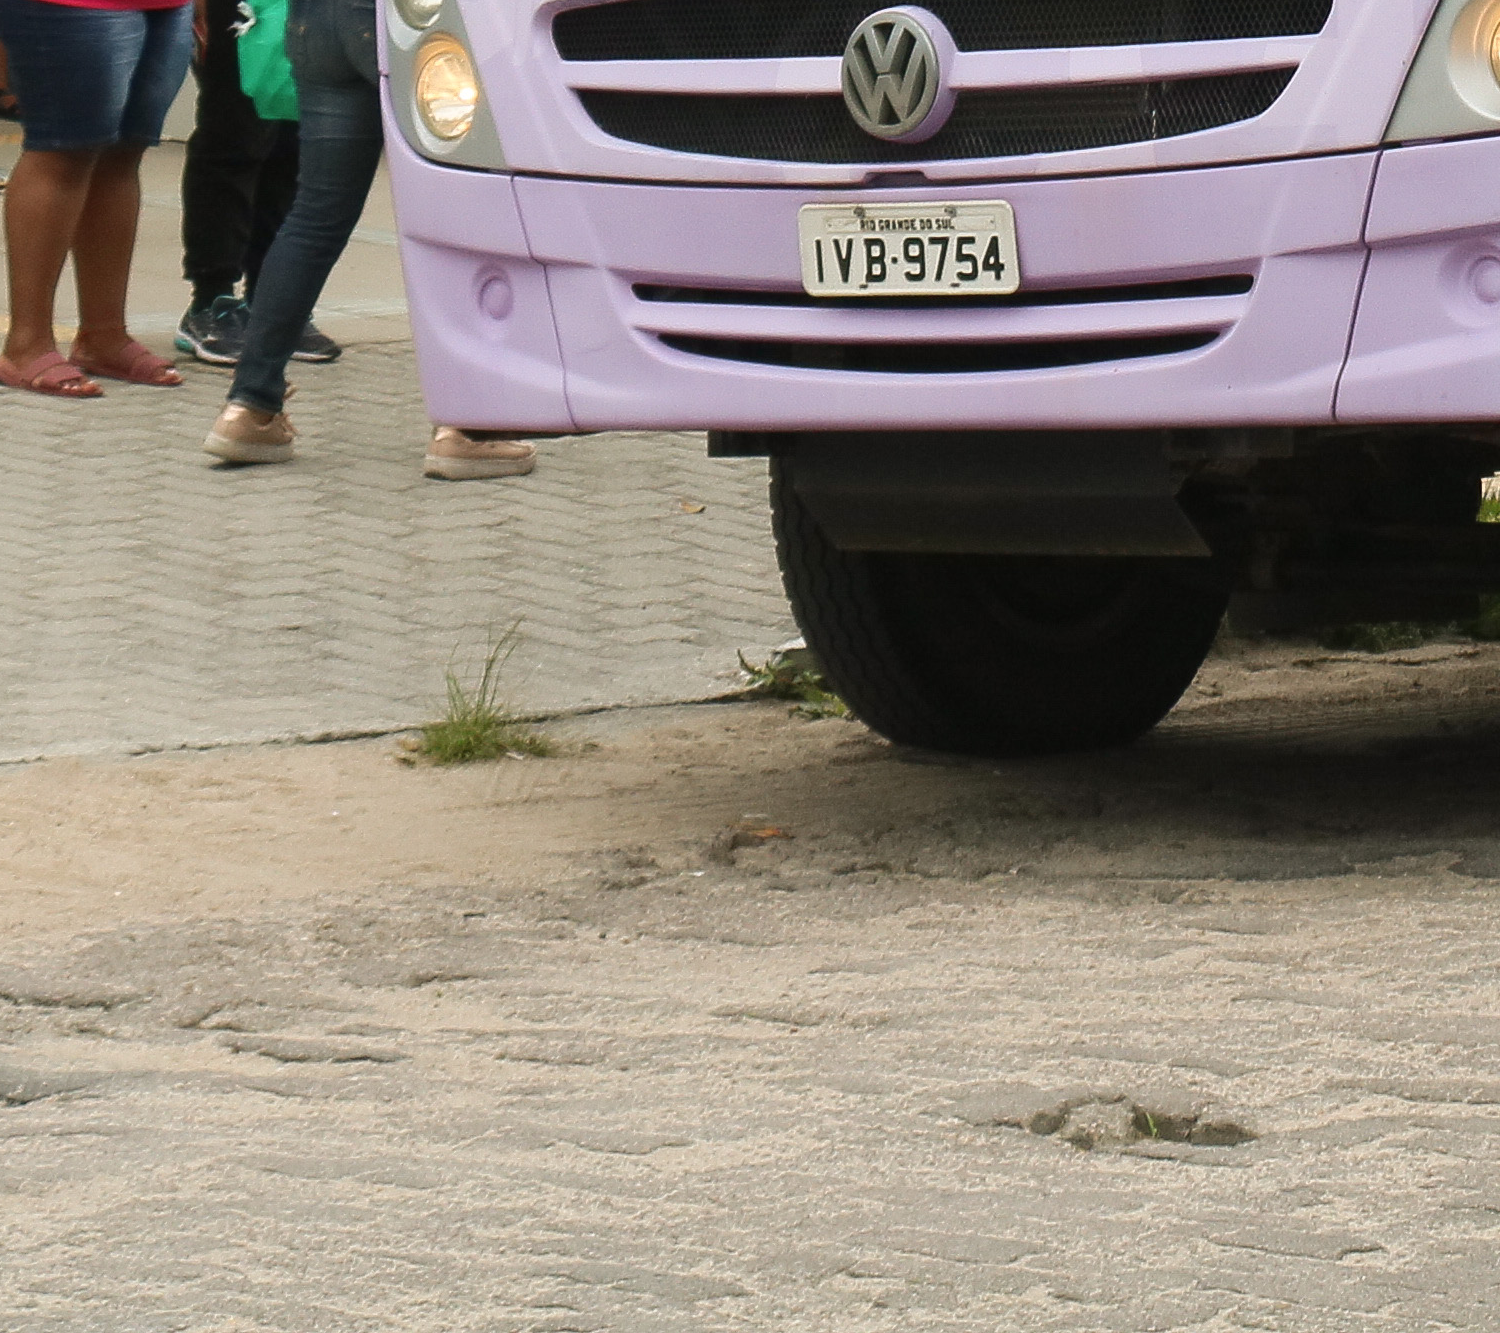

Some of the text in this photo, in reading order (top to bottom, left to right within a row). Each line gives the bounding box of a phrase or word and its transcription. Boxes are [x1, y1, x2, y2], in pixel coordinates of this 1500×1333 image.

[860, 218, 955, 231] RIO GRANDE DO SUL
